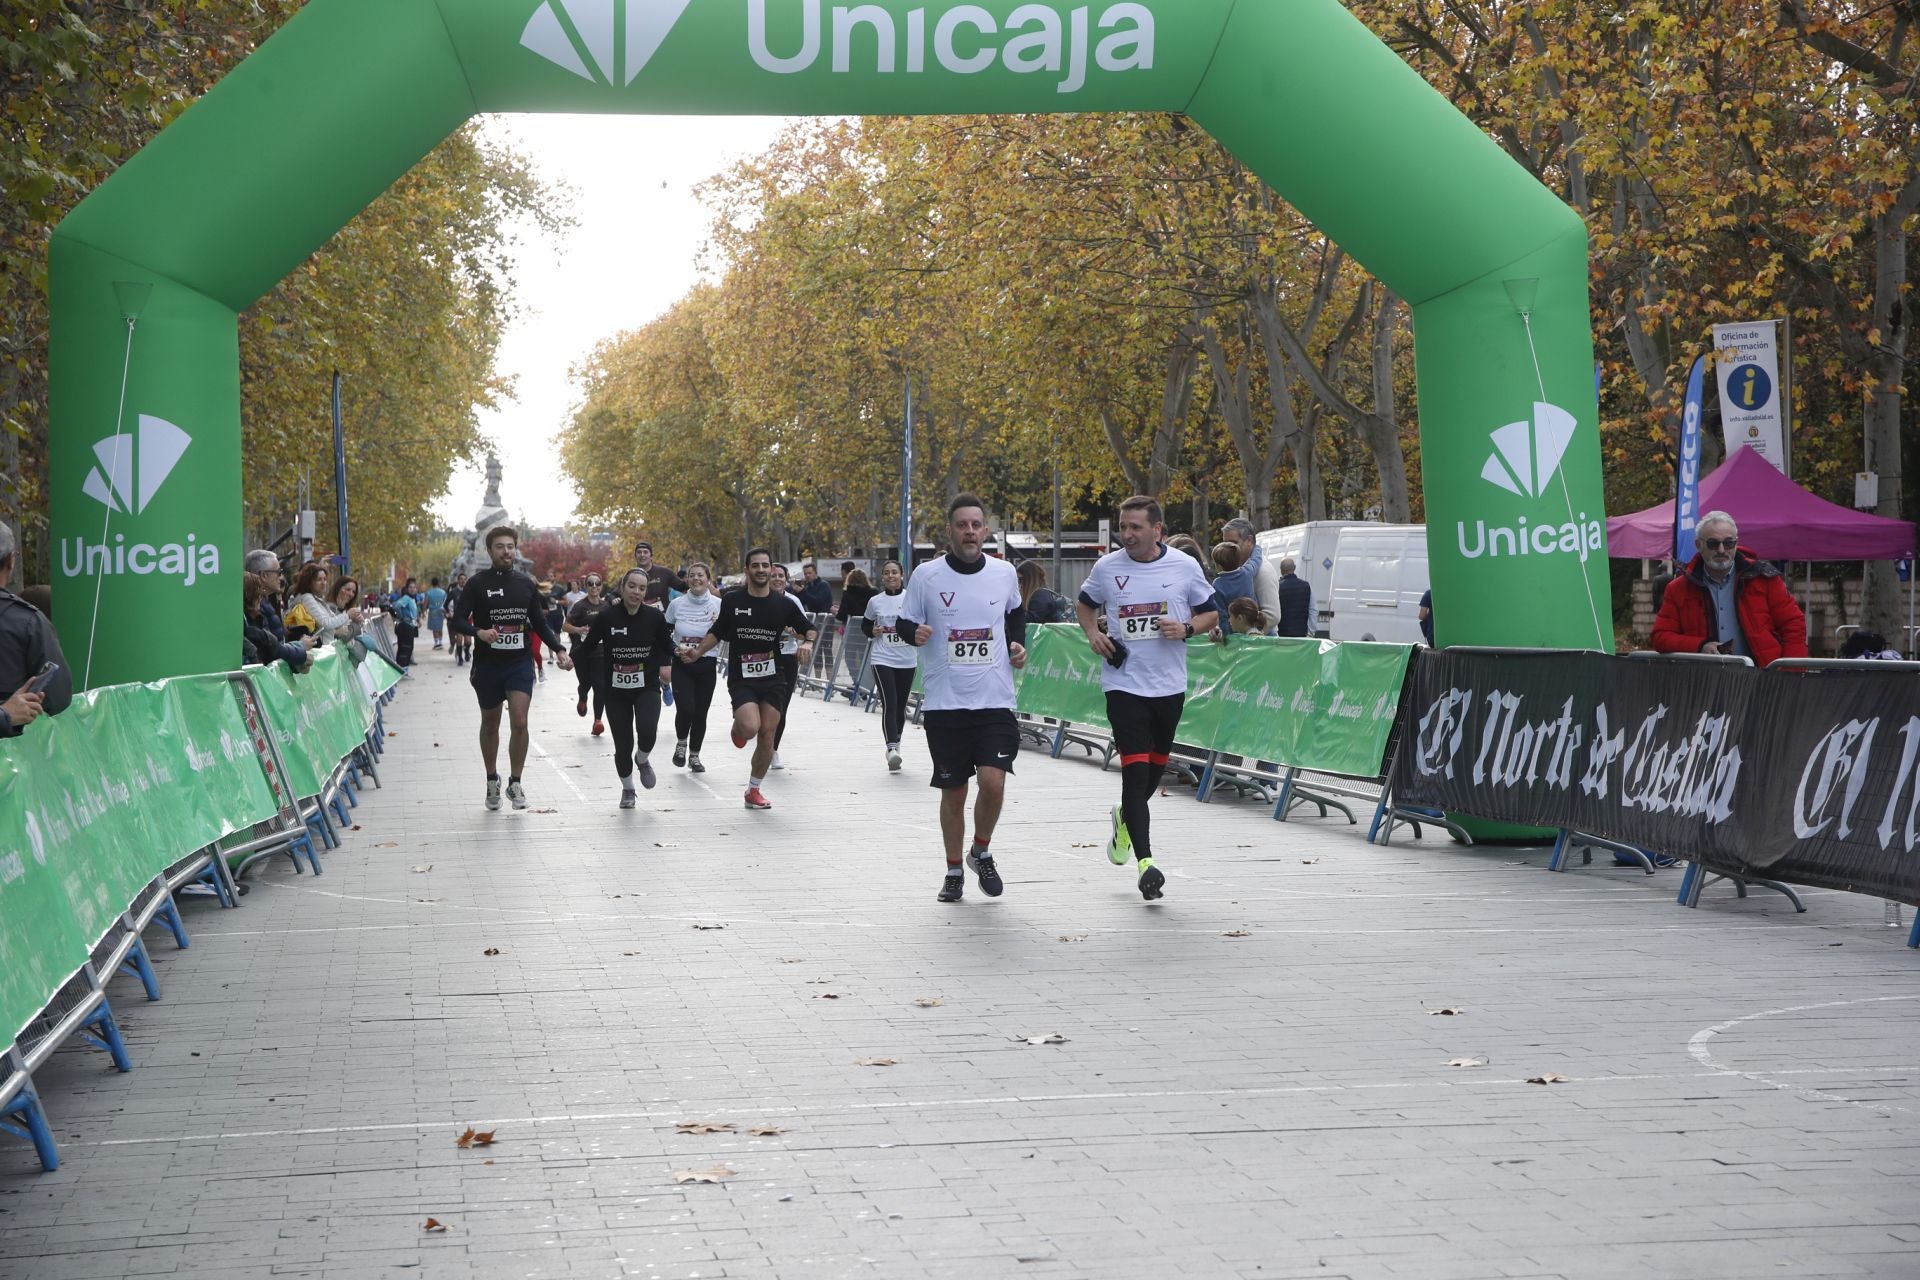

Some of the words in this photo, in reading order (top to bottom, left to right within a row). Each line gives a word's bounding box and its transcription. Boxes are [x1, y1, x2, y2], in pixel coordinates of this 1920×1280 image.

[747, 0, 1155, 93] Unicaja
[1721, 332, 1748, 341] Oficina
[1749, 331, 1759, 339] de
[1681, 401, 1699, 531] IVECO
[1457, 511, 1602, 563] Unicaja
[61, 533, 219, 586] Unicaja
[1126, 616, 1161, 633] 875
[497, 634, 520, 645] 506
[955, 642, 989, 657] 876
[747, 661, 770, 673] 507
[616, 673, 640, 684] 505
[1473, 688, 1583, 792] Norte
[1621, 702, 1744, 826] Castilla
